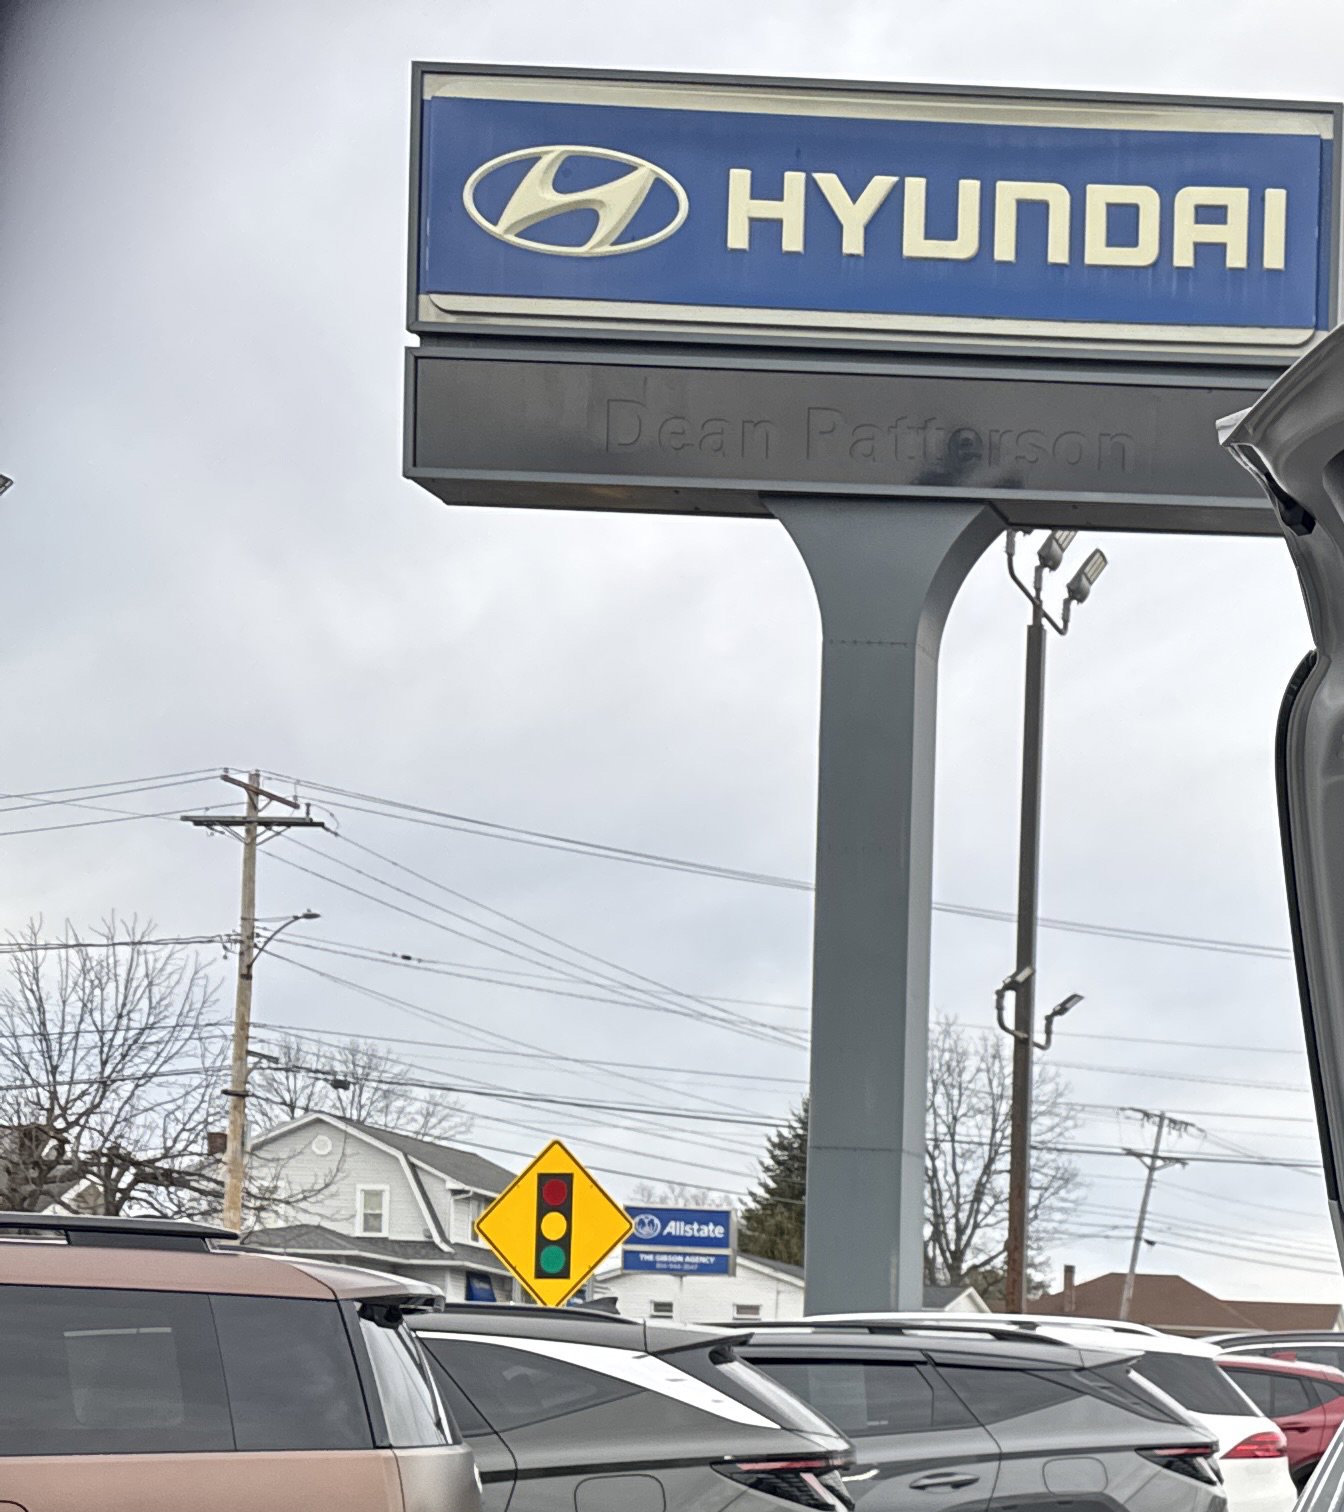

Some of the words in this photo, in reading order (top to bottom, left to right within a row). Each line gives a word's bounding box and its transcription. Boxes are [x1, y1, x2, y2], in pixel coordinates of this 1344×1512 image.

[727, 168, 1288, 271] HYUNDAI
[604, 398, 776, 461] Dean
[804, 406, 1137, 473] Patterson
[662, 1220, 726, 1239] Allstate
[639, 1254, 654, 1262] THE
